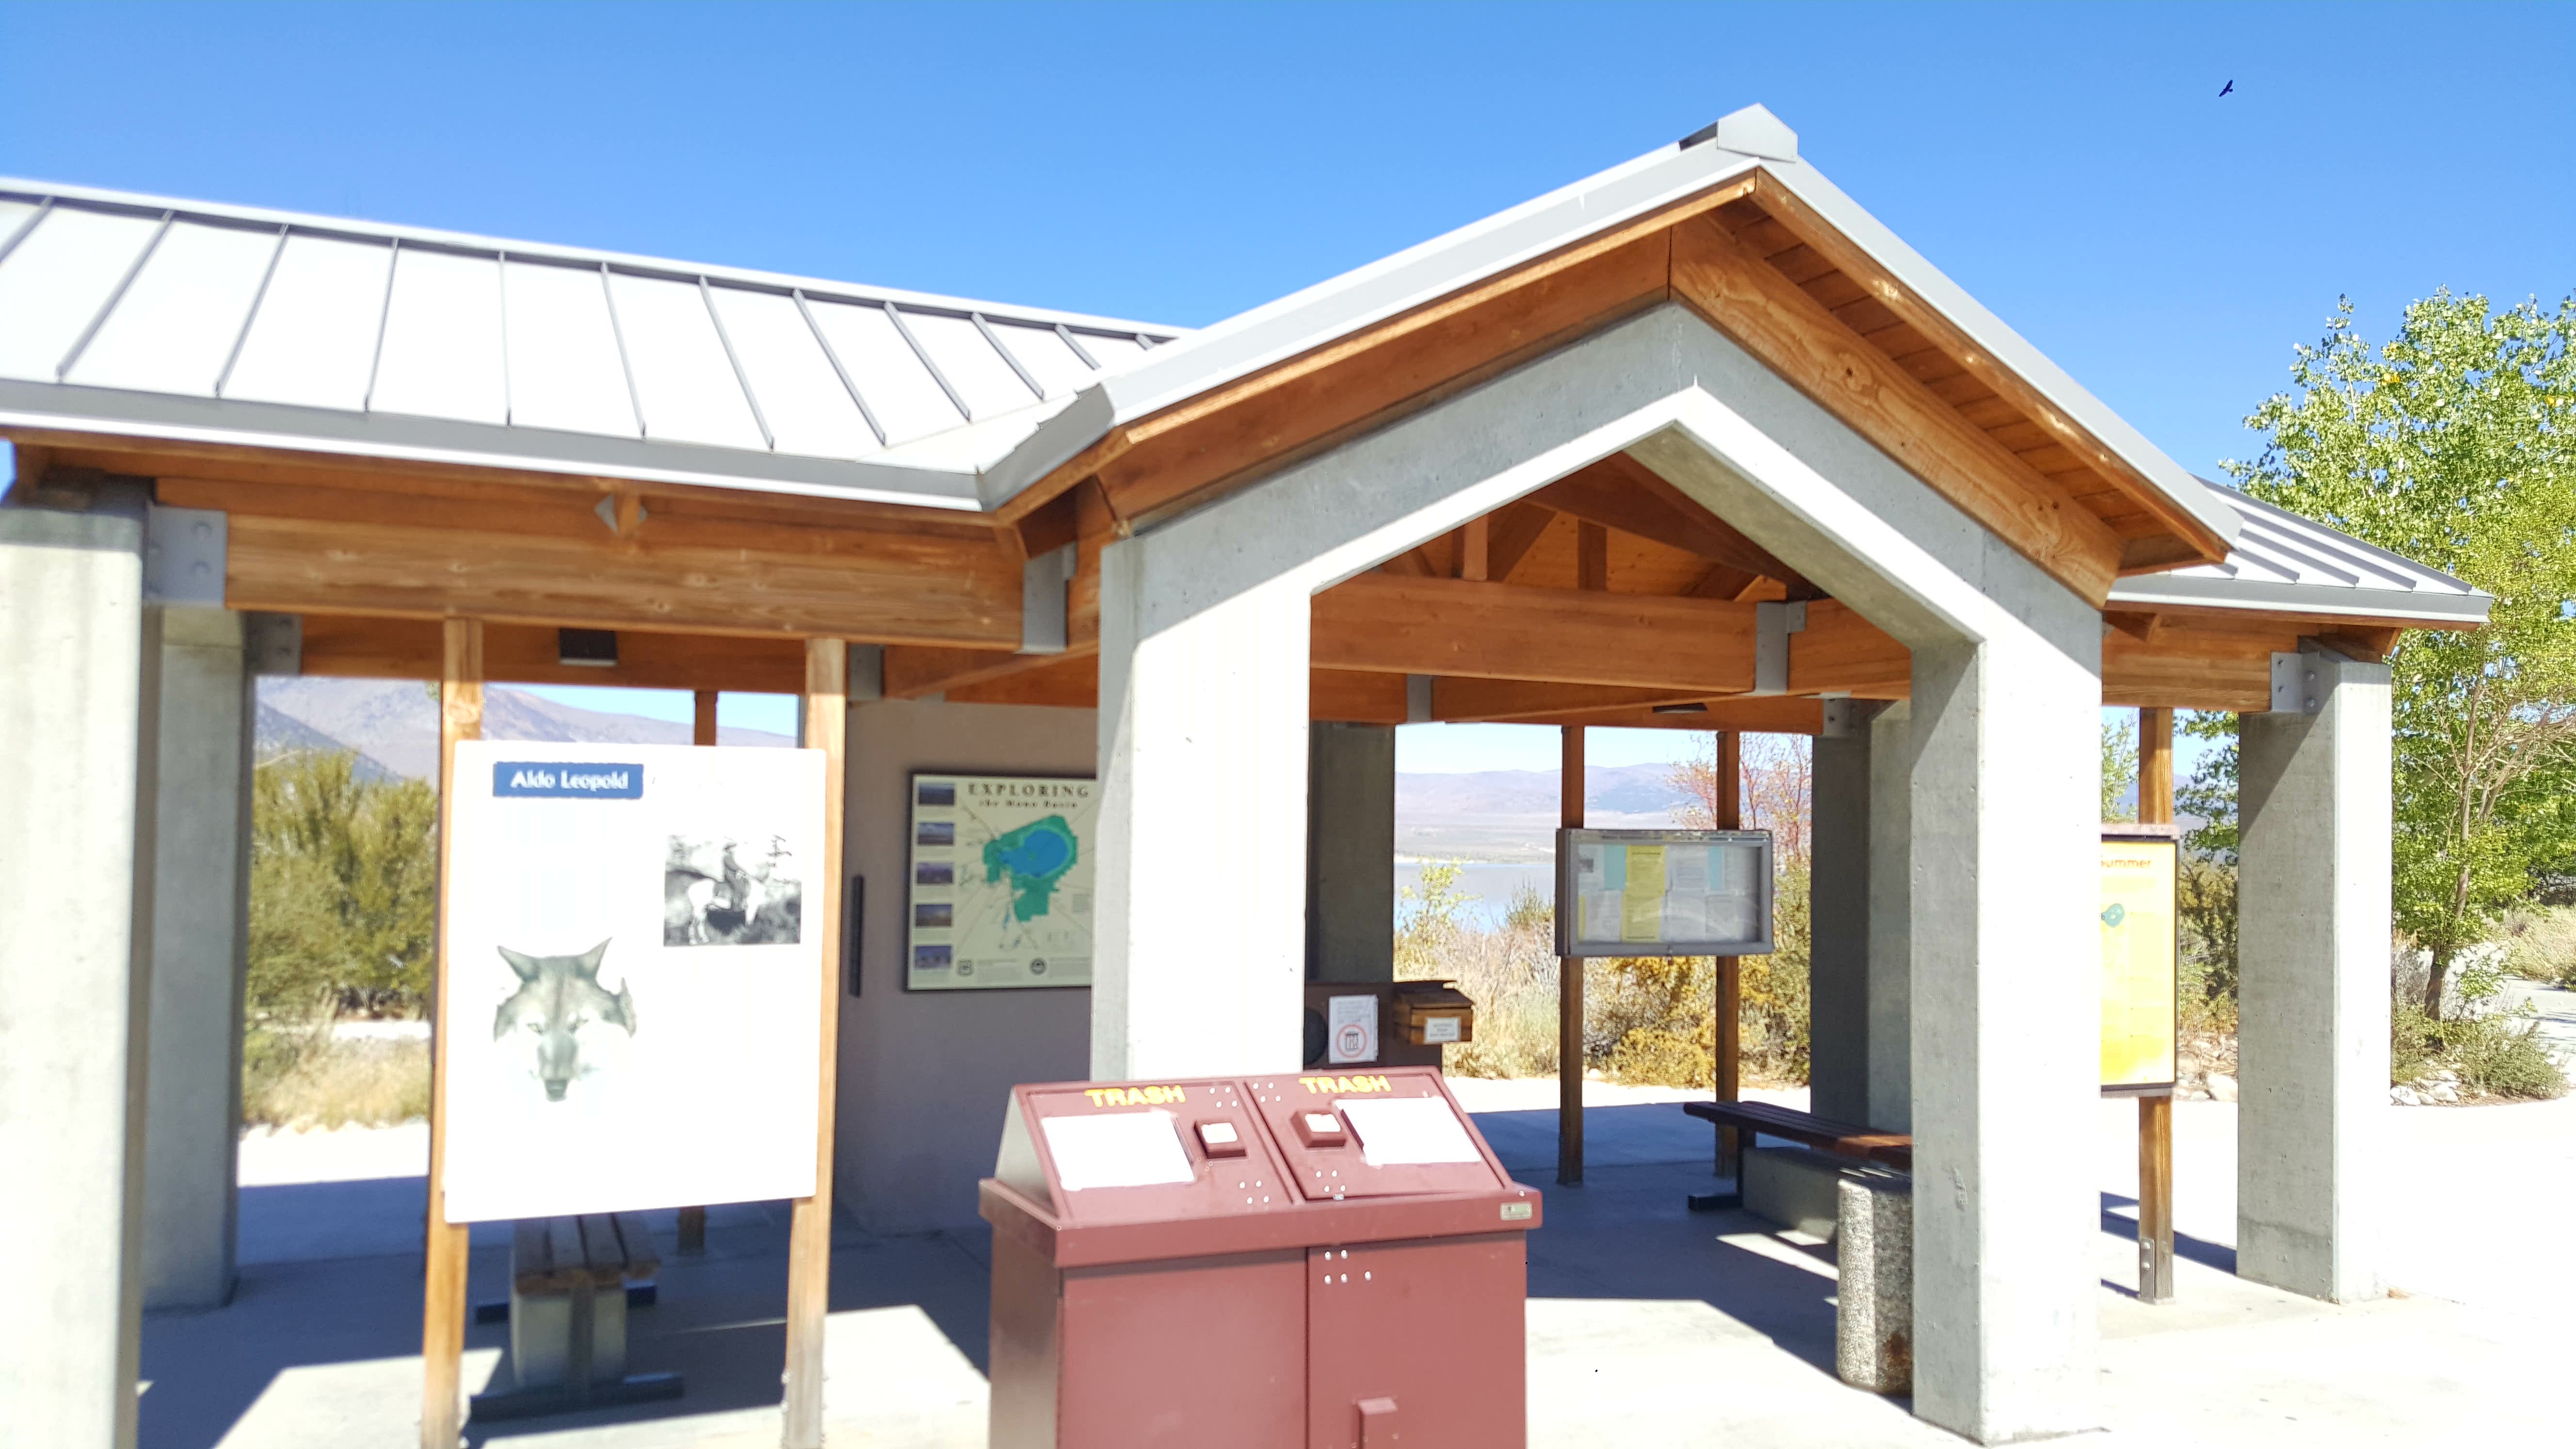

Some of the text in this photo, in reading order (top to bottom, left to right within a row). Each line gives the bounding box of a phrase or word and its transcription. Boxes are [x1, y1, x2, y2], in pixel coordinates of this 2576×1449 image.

[510, 770, 556, 789] Aldo
[561, 770, 629, 792] Leopold
[968, 783, 1089, 799] EXPLORING
[1299, 1075, 1392, 1095] TRASH
[1084, 1085, 1186, 1108] TRASH
